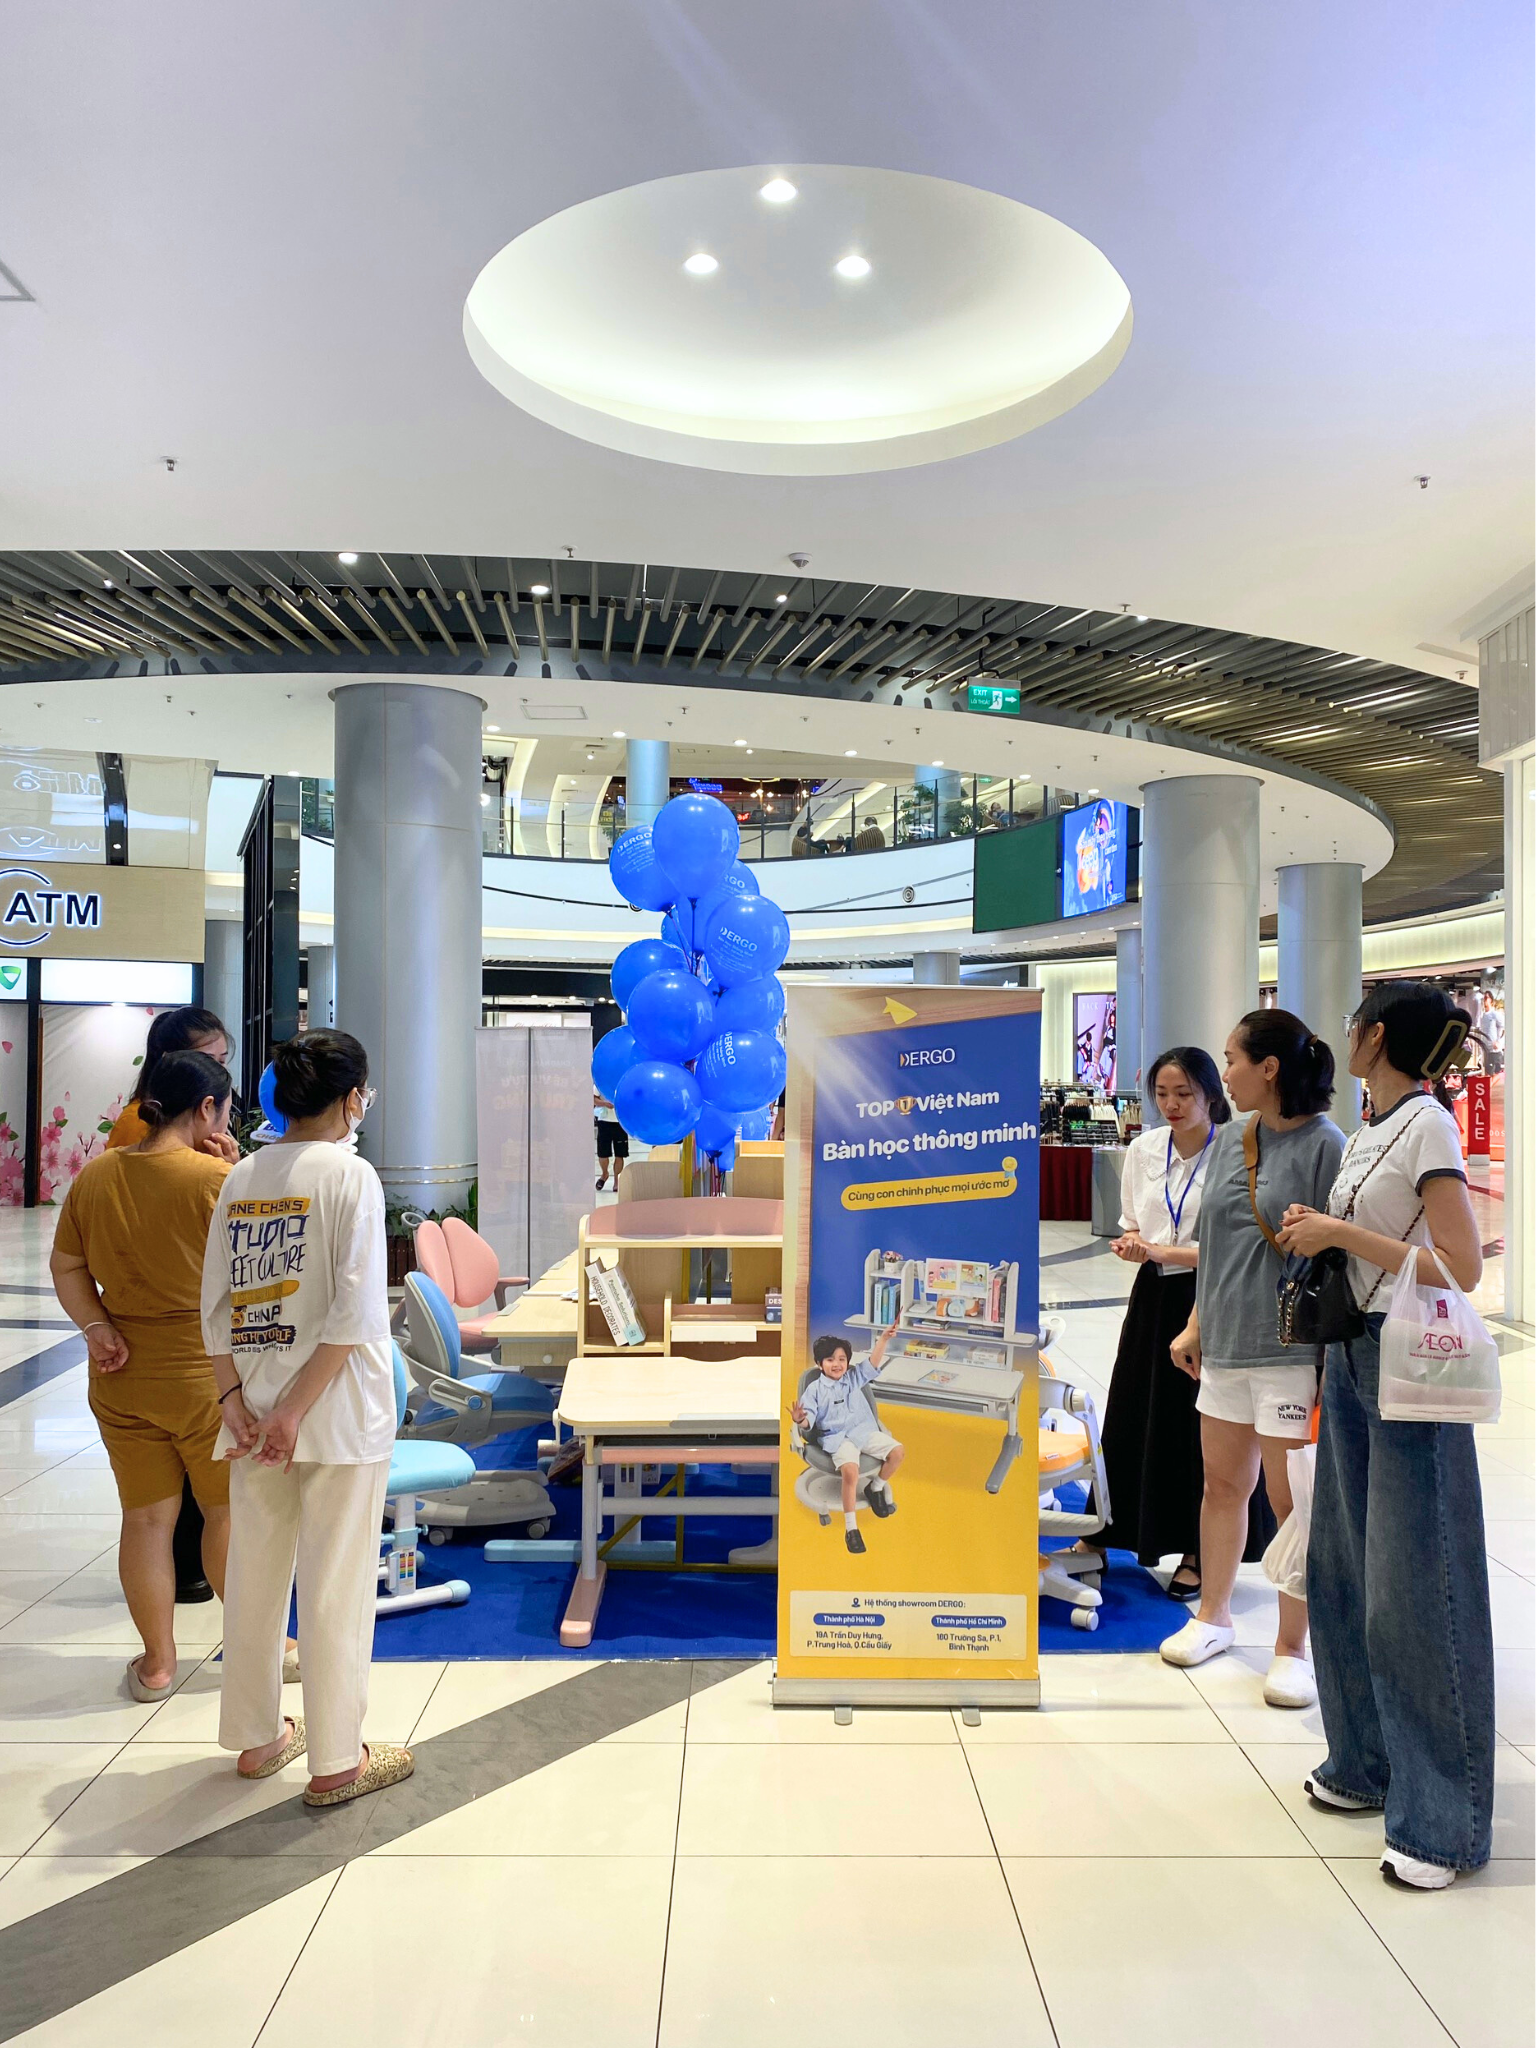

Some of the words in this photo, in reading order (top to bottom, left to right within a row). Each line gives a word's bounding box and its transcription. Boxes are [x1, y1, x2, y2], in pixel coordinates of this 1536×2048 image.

[4, 892, 99, 926] ATM
[720, 926, 758, 952] DERGO
[725, 1031, 737, 1066] DERGO
[900, 1048, 956, 1067] DERGO
[856, 1100, 895, 1118] TOP
[916, 1093, 954, 1114] Việt
[956, 1091, 1000, 1108] Nam
[1474, 1082, 1486, 1140] SALE
[823, 1140, 864, 1161] Bàn
[868, 1138, 910, 1160] học
[912, 1129, 978, 1150] thông
[981, 1122, 1037, 1144] minh
[848, 1190, 875, 1202] Cùng
[876, 1190, 895, 1199] con
[924, 1183, 951, 1197] phục
[951, 1181, 970, 1194] mọi
[971, 1179, 992, 1190] ước
[993, 1178, 1011, 1188] mơ
[603, 1306, 620, 1336] DECORATES
[1277, 1404, 1292, 1413] NEW
[1292, 1404, 1307, 1415] YORK
[864, 1599, 874, 1608] Hệ
[875, 1599, 897, 1608] thống
[898, 1599, 937, 1608] showroom
[937, 1600, 966, 1608] DERGO:
[823, 1615, 843, 1623] Thành
[843, 1615, 855, 1624] phố
[855, 1615, 865, 1623] Hà
[865, 1615, 876, 1625] Nội
[935, 1617, 955, 1625] Thành
[955, 1617, 967, 1626] phố
[968, 1617, 977, 1625] Hồ
[807, 1640, 836, 1650] P.Trung
[847, 1632, 862, 1641] Duy
[977, 1634, 989, 1643] Sa,
[948, 1643, 966, 1651] Bình
[966, 1643, 990, 1653] Thạnh
